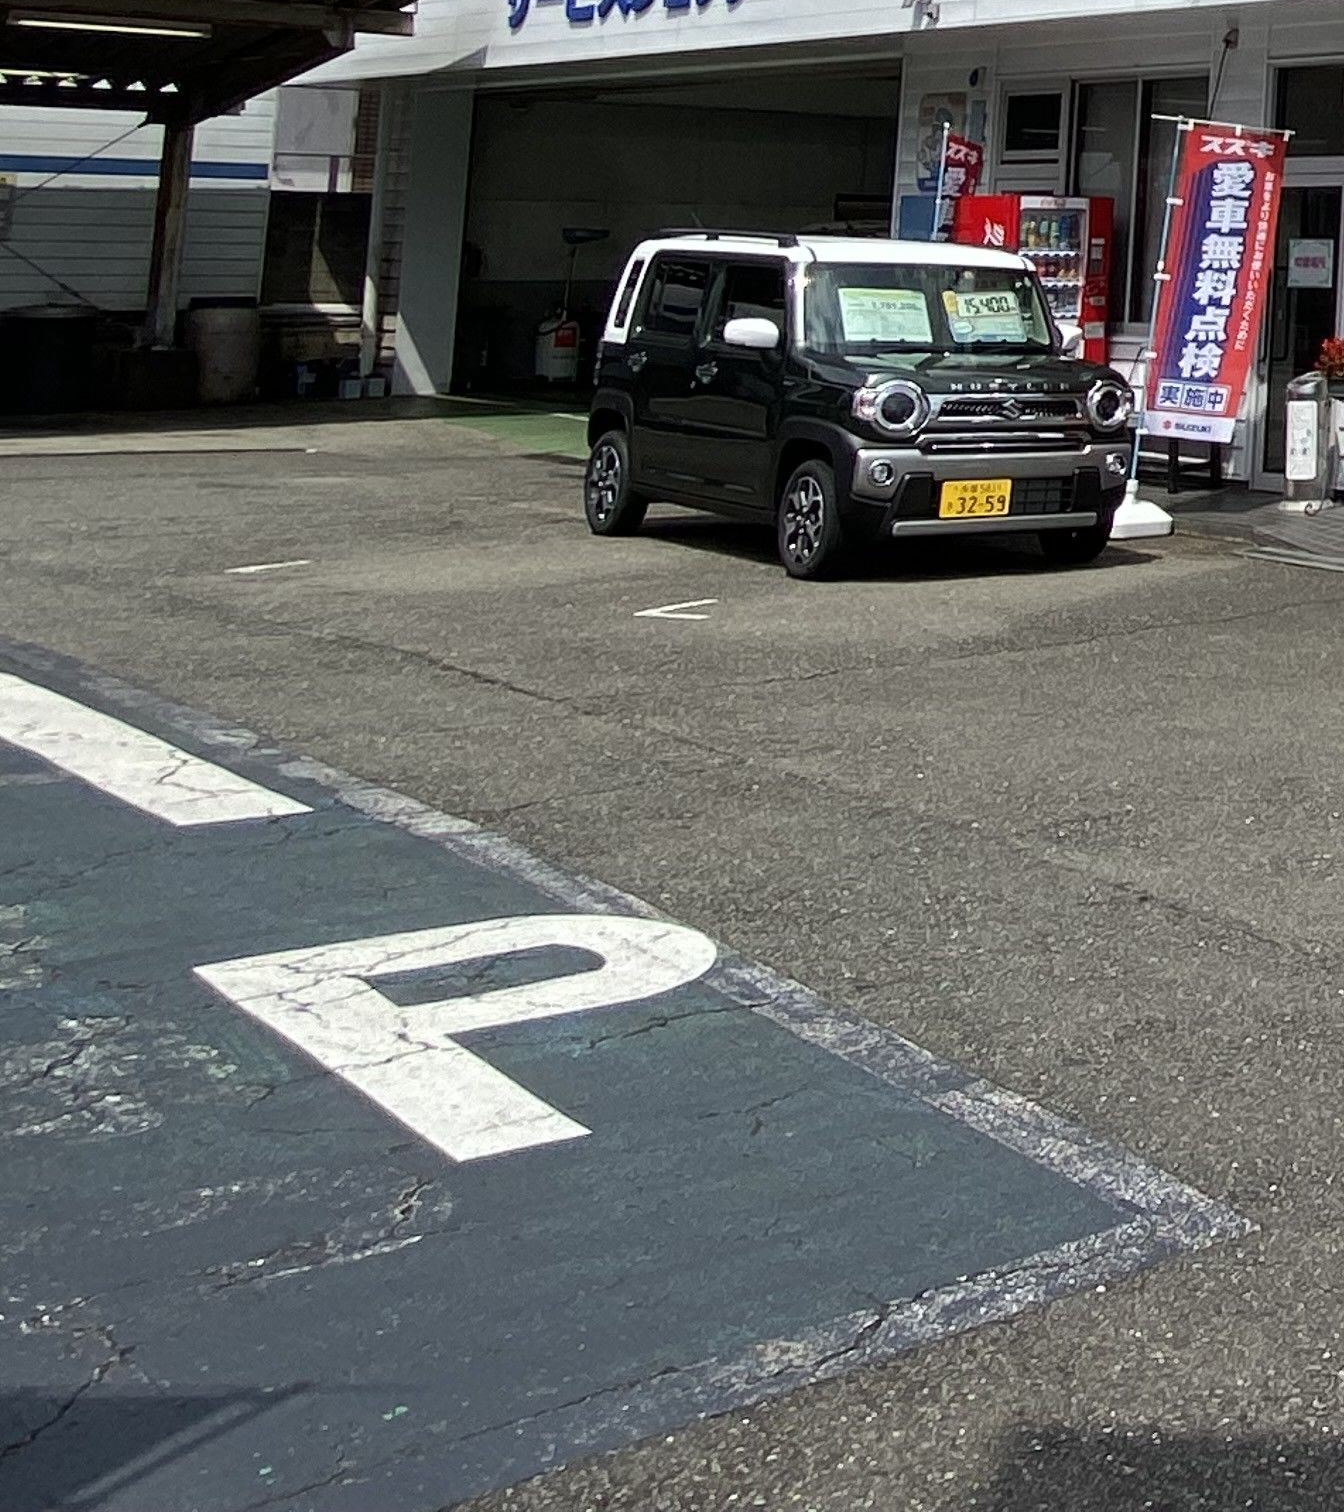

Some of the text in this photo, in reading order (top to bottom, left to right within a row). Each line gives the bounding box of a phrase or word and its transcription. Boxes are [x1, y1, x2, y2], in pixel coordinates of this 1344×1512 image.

[1200, 134, 1275, 158] スズキ
[1177, 161, 1256, 379] 愛車無料点検
[1159, 384, 1225, 410] 実施中
[192, 913, 719, 1164] P
